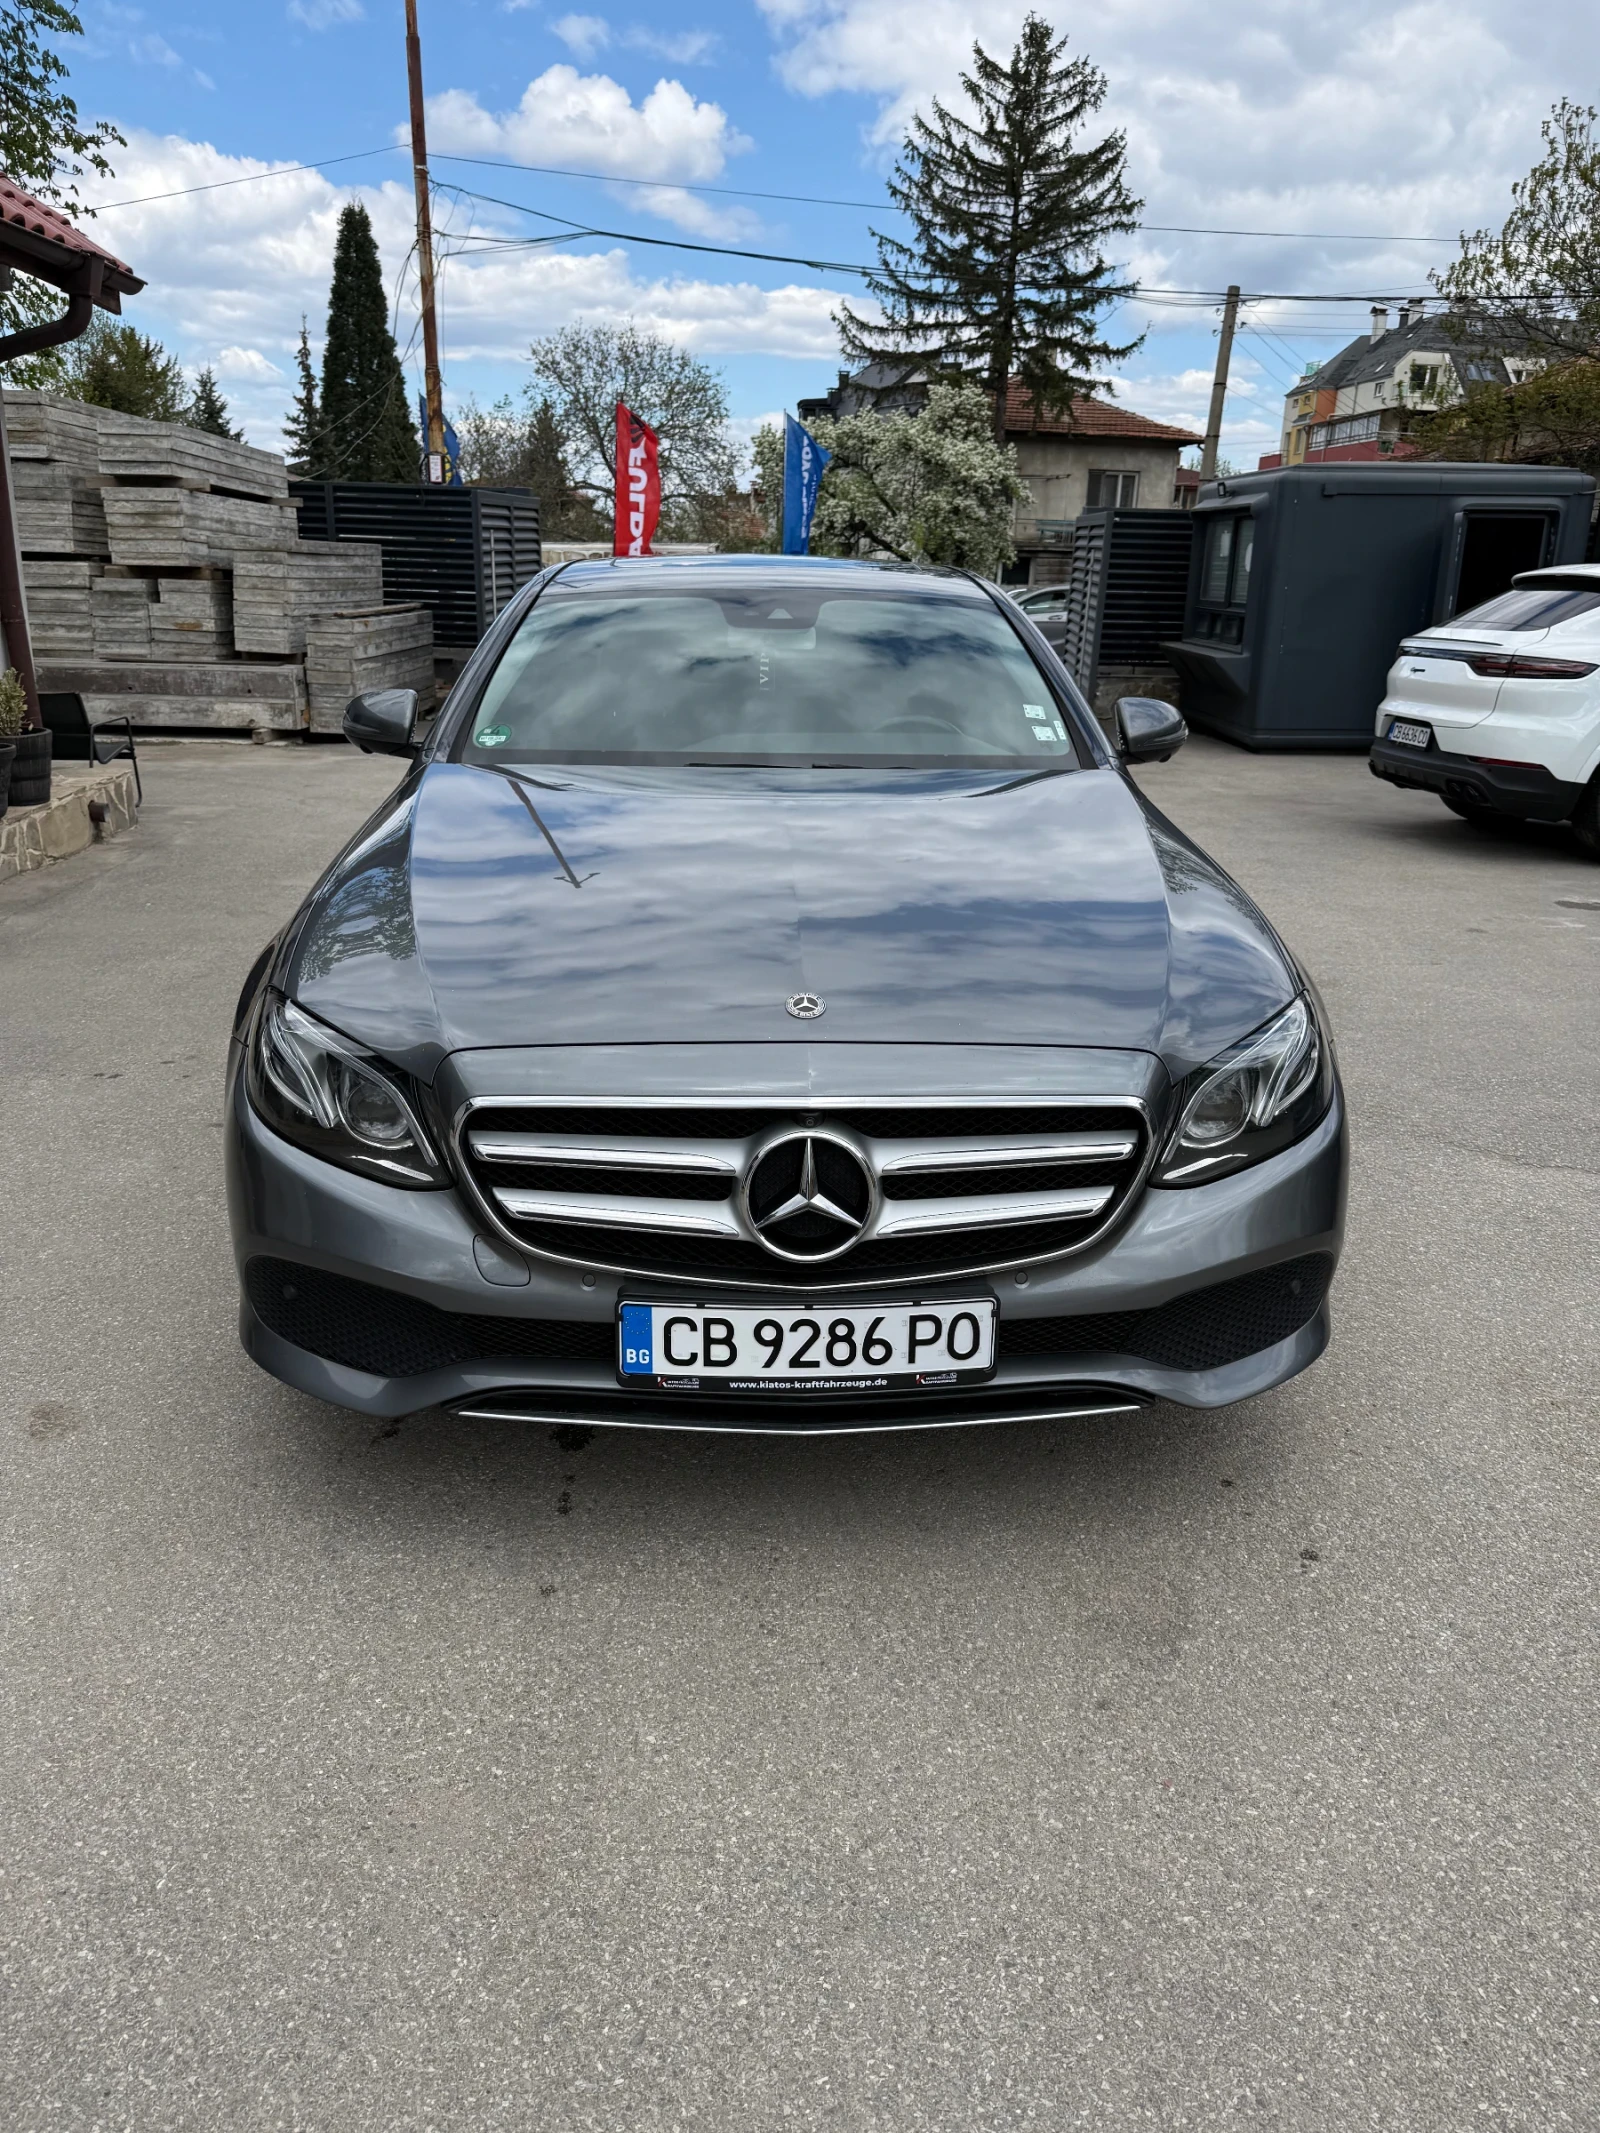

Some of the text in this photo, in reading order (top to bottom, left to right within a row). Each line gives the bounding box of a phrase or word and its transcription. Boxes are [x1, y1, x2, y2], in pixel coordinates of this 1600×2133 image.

[626, 1348, 650, 1364] BG
[663, 1316, 738, 1368] CB
[753, 1316, 893, 1369] 9286
